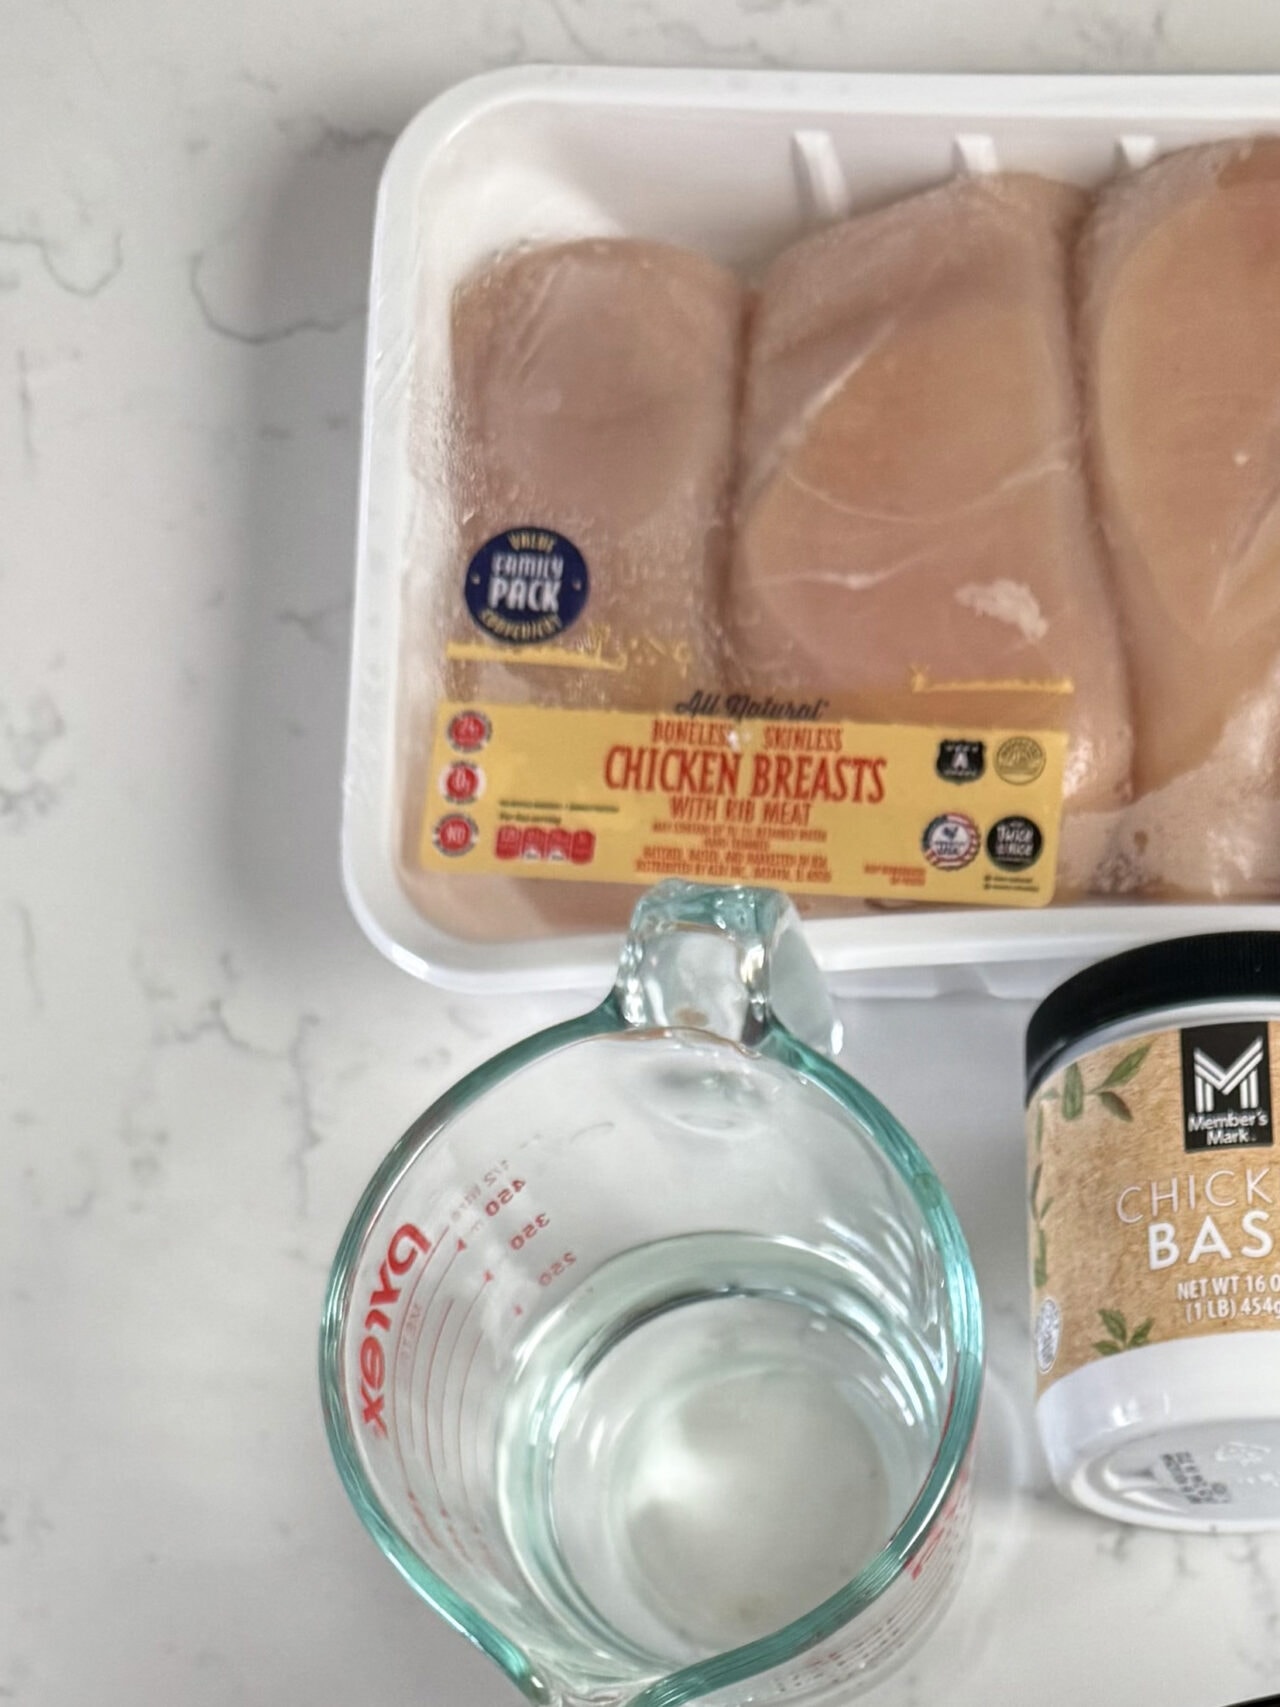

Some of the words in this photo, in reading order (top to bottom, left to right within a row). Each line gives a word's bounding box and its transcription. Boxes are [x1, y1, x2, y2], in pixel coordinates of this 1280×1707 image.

[507, 531, 556, 553] VALUE
[491, 552, 564, 580] FAMILY
[488, 577, 560, 613] PACK
[674, 689, 720, 718] All
[764, 725, 843, 752] SKINLESS
[603, 744, 742, 797] CHICKEN
[750, 753, 888, 804] BREASTS
[671, 796, 718, 820] WITH
[726, 799, 755, 823] RIB
[763, 802, 811, 826] MEAT
[1187, 1109, 1268, 1132] Member's
[1177, 1278, 1208, 1300] NET
[1211, 1275, 1239, 1296] WT
[1245, 1275, 1266, 1293] 16
[1186, 1301, 1202, 1323] (1
[1207, 1298, 1237, 1320] LB)
